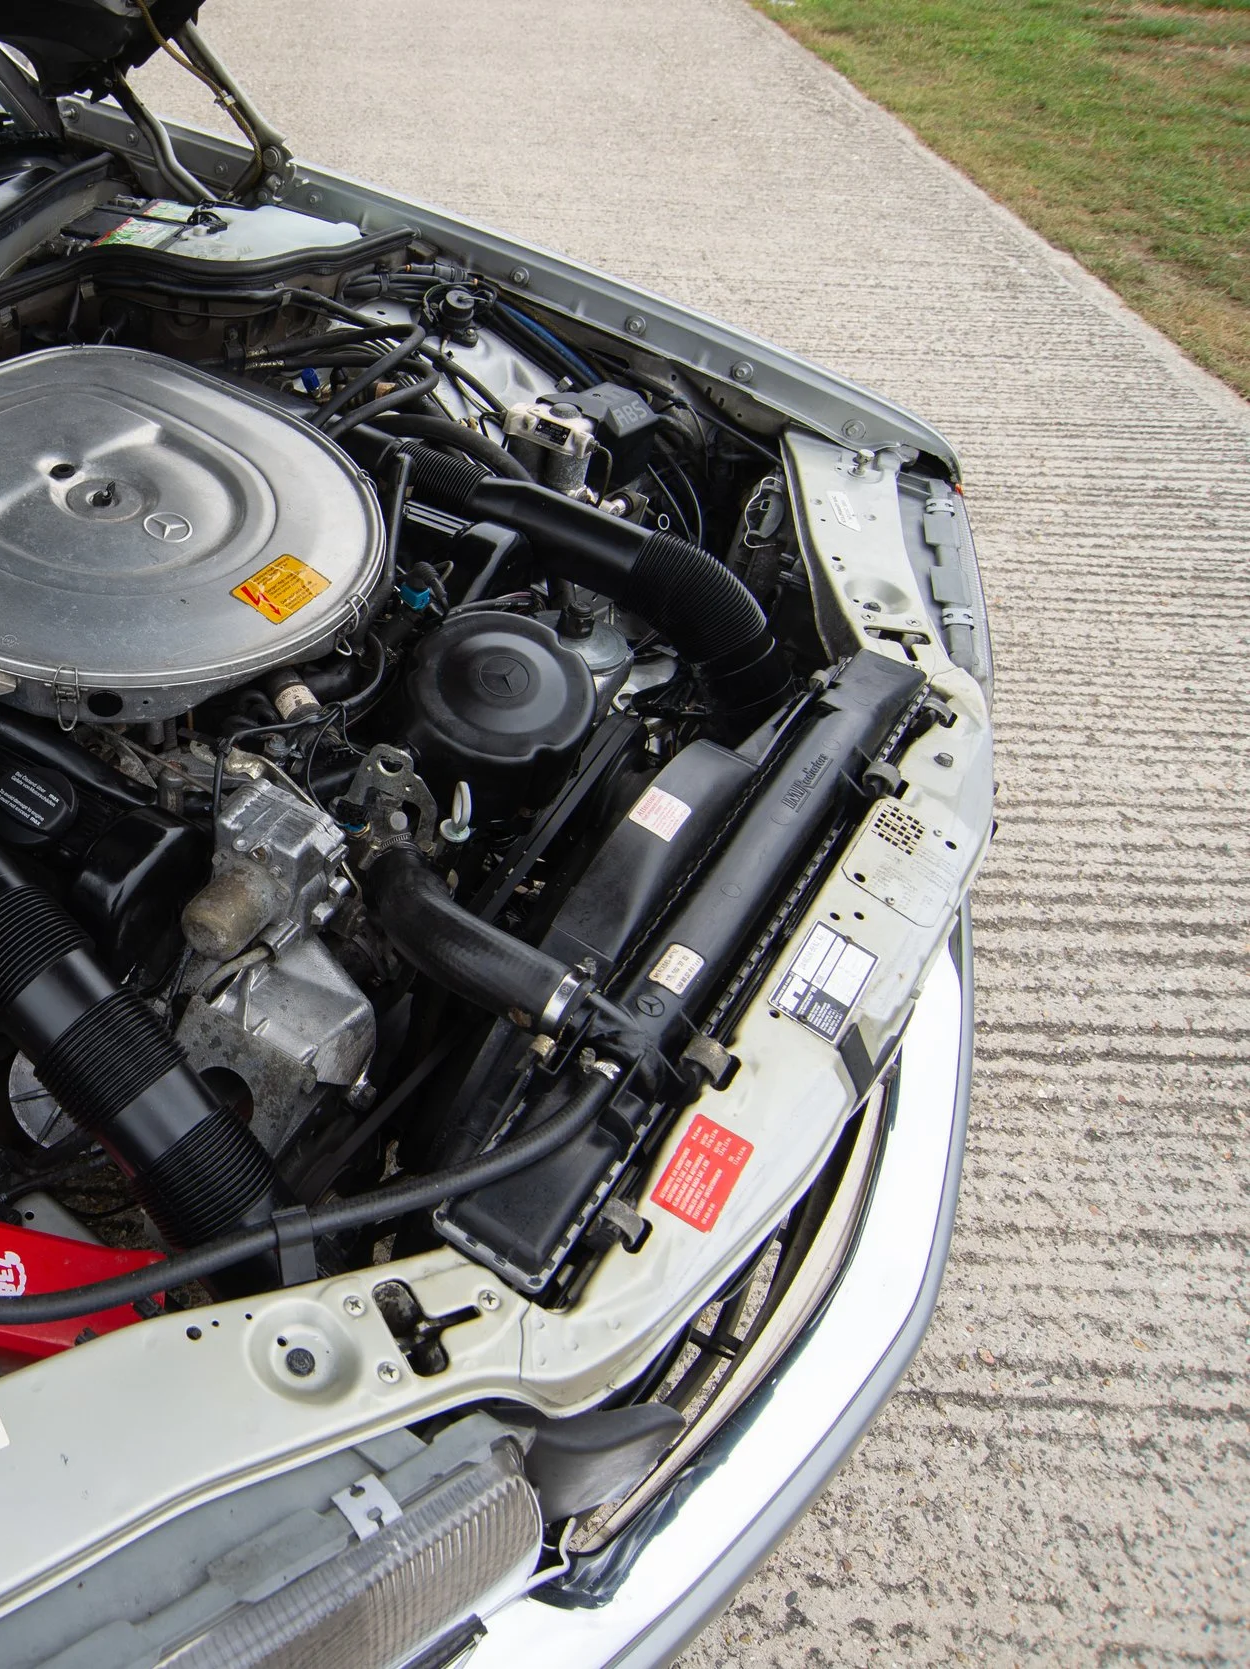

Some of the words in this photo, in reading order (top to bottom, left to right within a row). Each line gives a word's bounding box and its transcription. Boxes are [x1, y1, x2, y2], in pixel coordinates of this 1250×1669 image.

[613, 400, 648, 428] ABS
[48, 794, 59, 803] max
[30, 816, 40, 826] max
